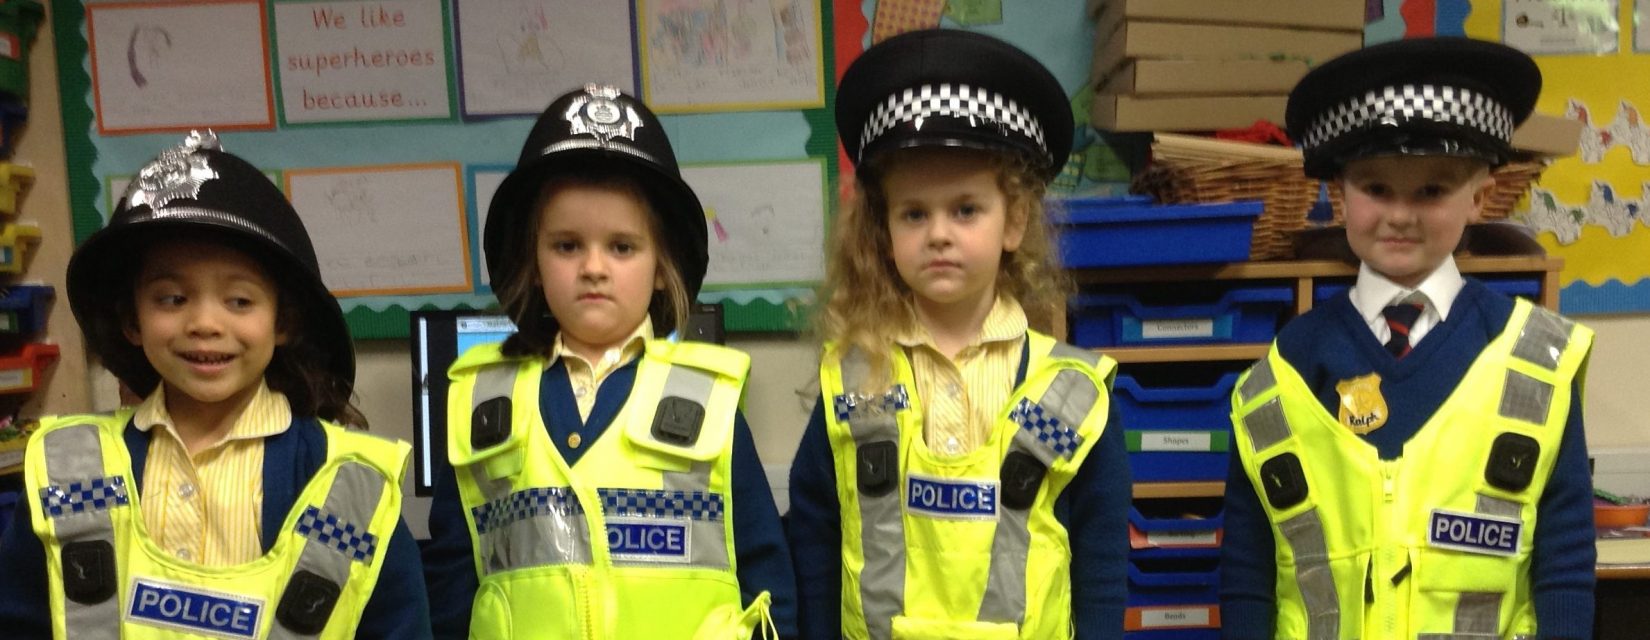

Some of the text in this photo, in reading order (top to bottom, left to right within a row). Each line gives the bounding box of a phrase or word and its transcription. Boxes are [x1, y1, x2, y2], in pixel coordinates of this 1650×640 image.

[312, 5, 406, 30] We like
[287, 46, 435, 77] superheroes
[302, 88, 427, 110] because...
[1349, 412, 1379, 428] Ralph
[912, 482, 992, 510] POLICE
[608, 527, 682, 550] OLICE
[1435, 517, 1514, 548] POLICE
[138, 588, 252, 631] POLICE
